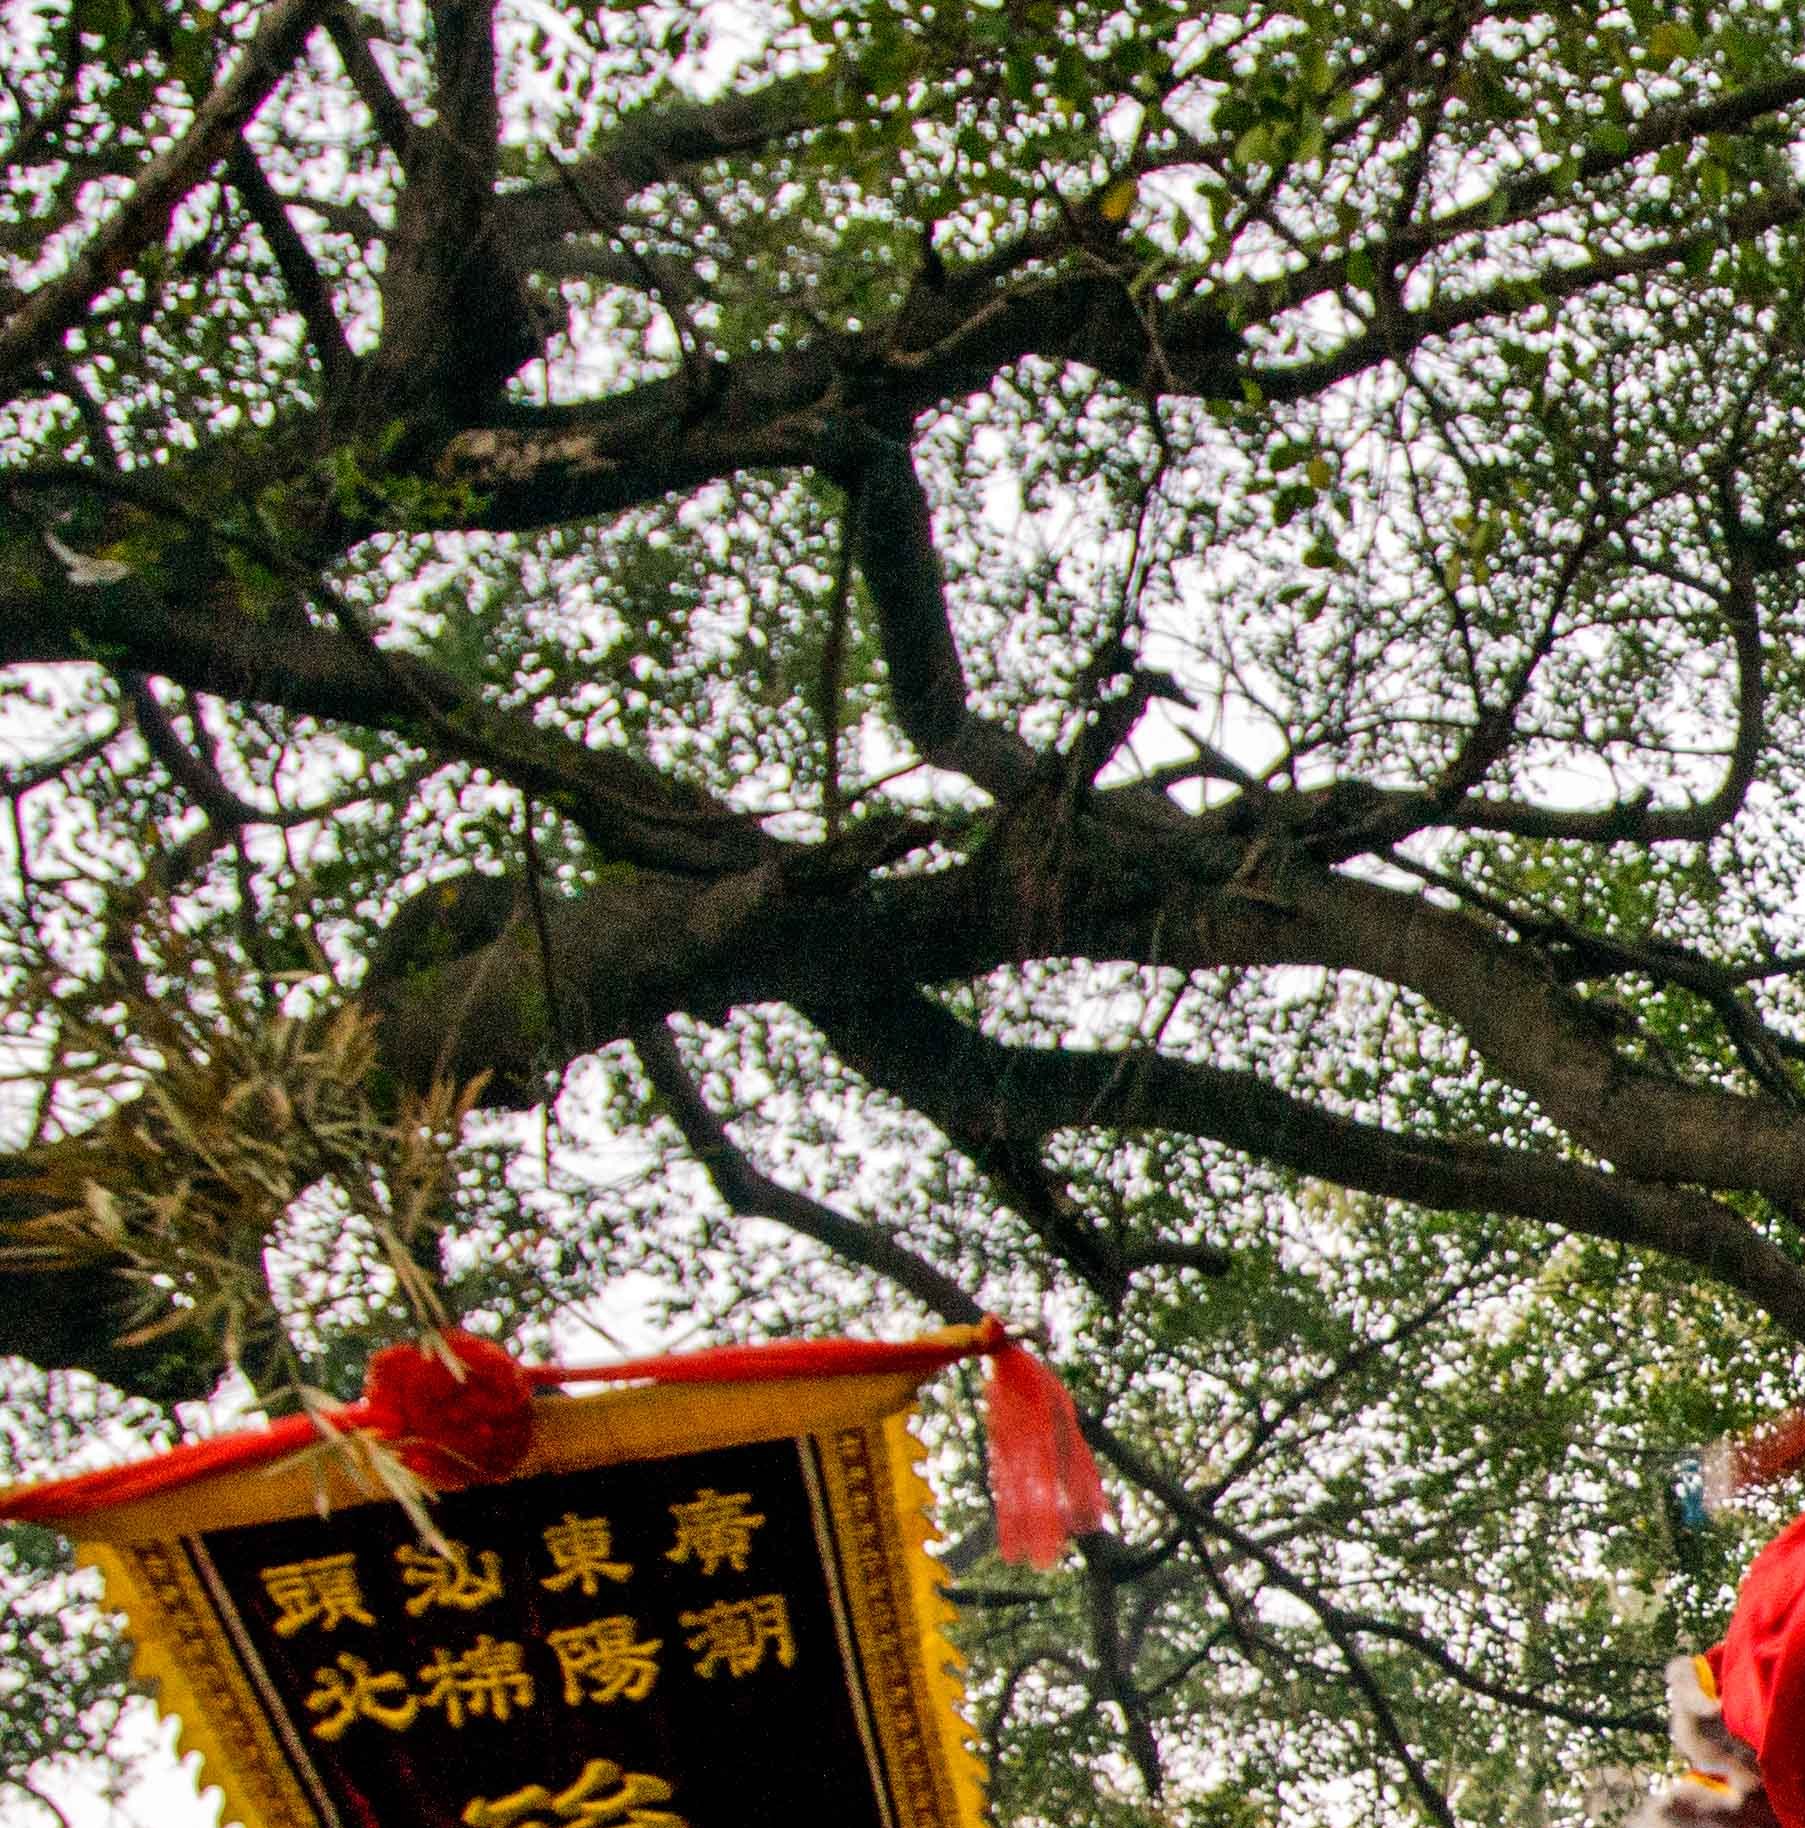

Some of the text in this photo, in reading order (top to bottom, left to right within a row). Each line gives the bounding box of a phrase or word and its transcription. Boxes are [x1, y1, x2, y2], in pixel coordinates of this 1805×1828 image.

[259, 1488, 767, 1638] 廣東汕頭
[305, 1592, 796, 1742] 潮陽棉北
